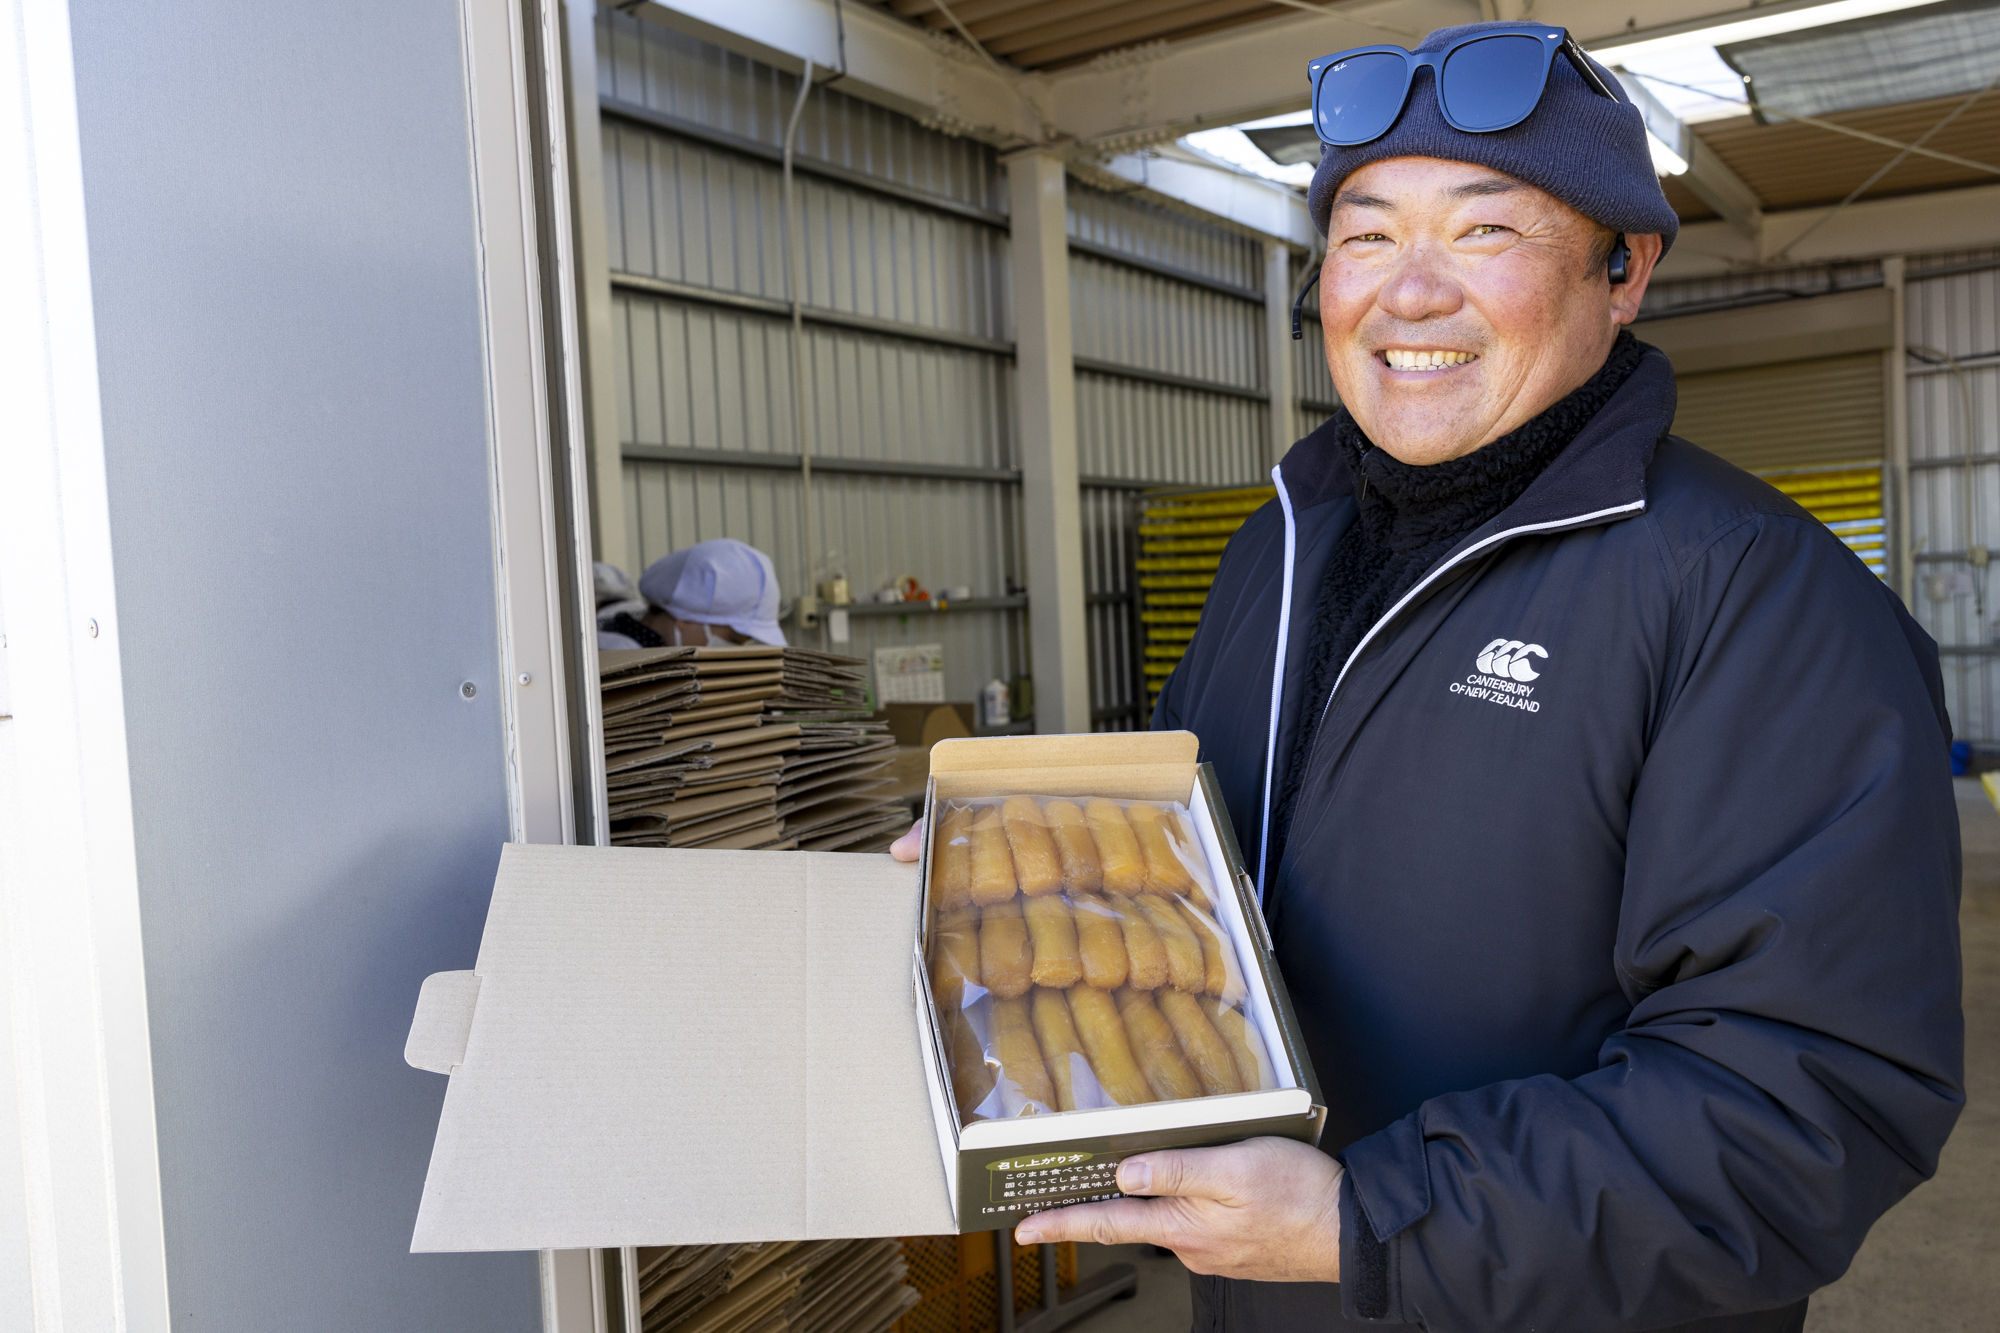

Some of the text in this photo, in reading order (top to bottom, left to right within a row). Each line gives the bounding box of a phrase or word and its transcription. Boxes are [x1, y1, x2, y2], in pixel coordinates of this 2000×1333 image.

[1449, 682, 1541, 713] OF NEW ZEALAND
[1466, 674, 1535, 698] CANTERBURY
[997, 1153, 1084, 1171] 召し上がり方
